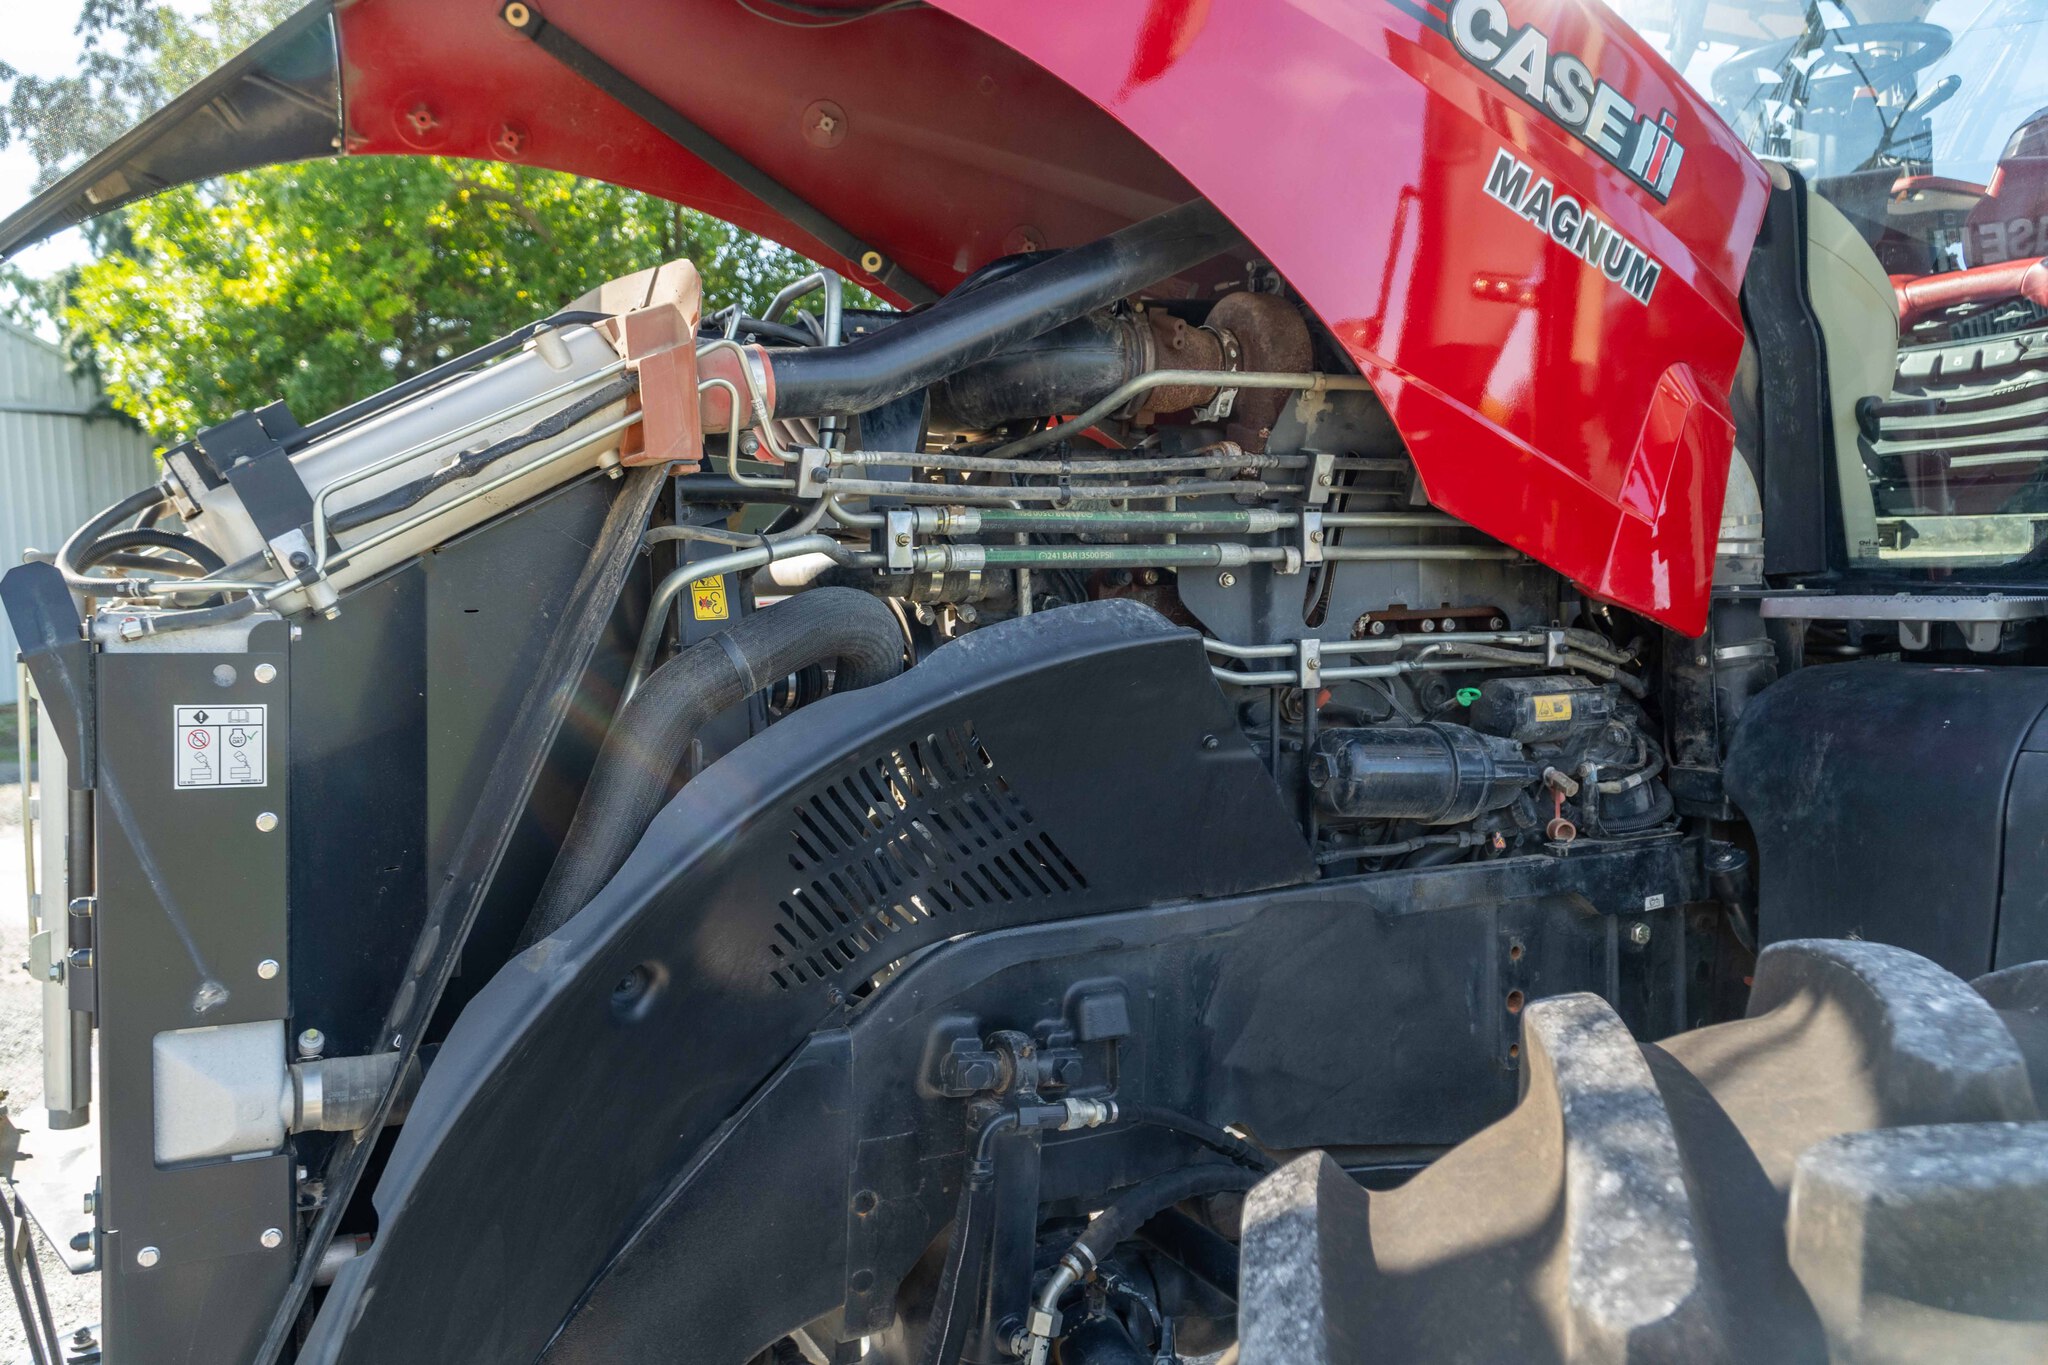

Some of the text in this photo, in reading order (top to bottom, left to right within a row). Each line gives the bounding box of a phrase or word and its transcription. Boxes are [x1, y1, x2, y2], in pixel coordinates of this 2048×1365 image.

[1452, 0, 1636, 160] CASE
[1483, 146, 1662, 307] MAGNUM
[1062, 551, 1078, 559] BAR
